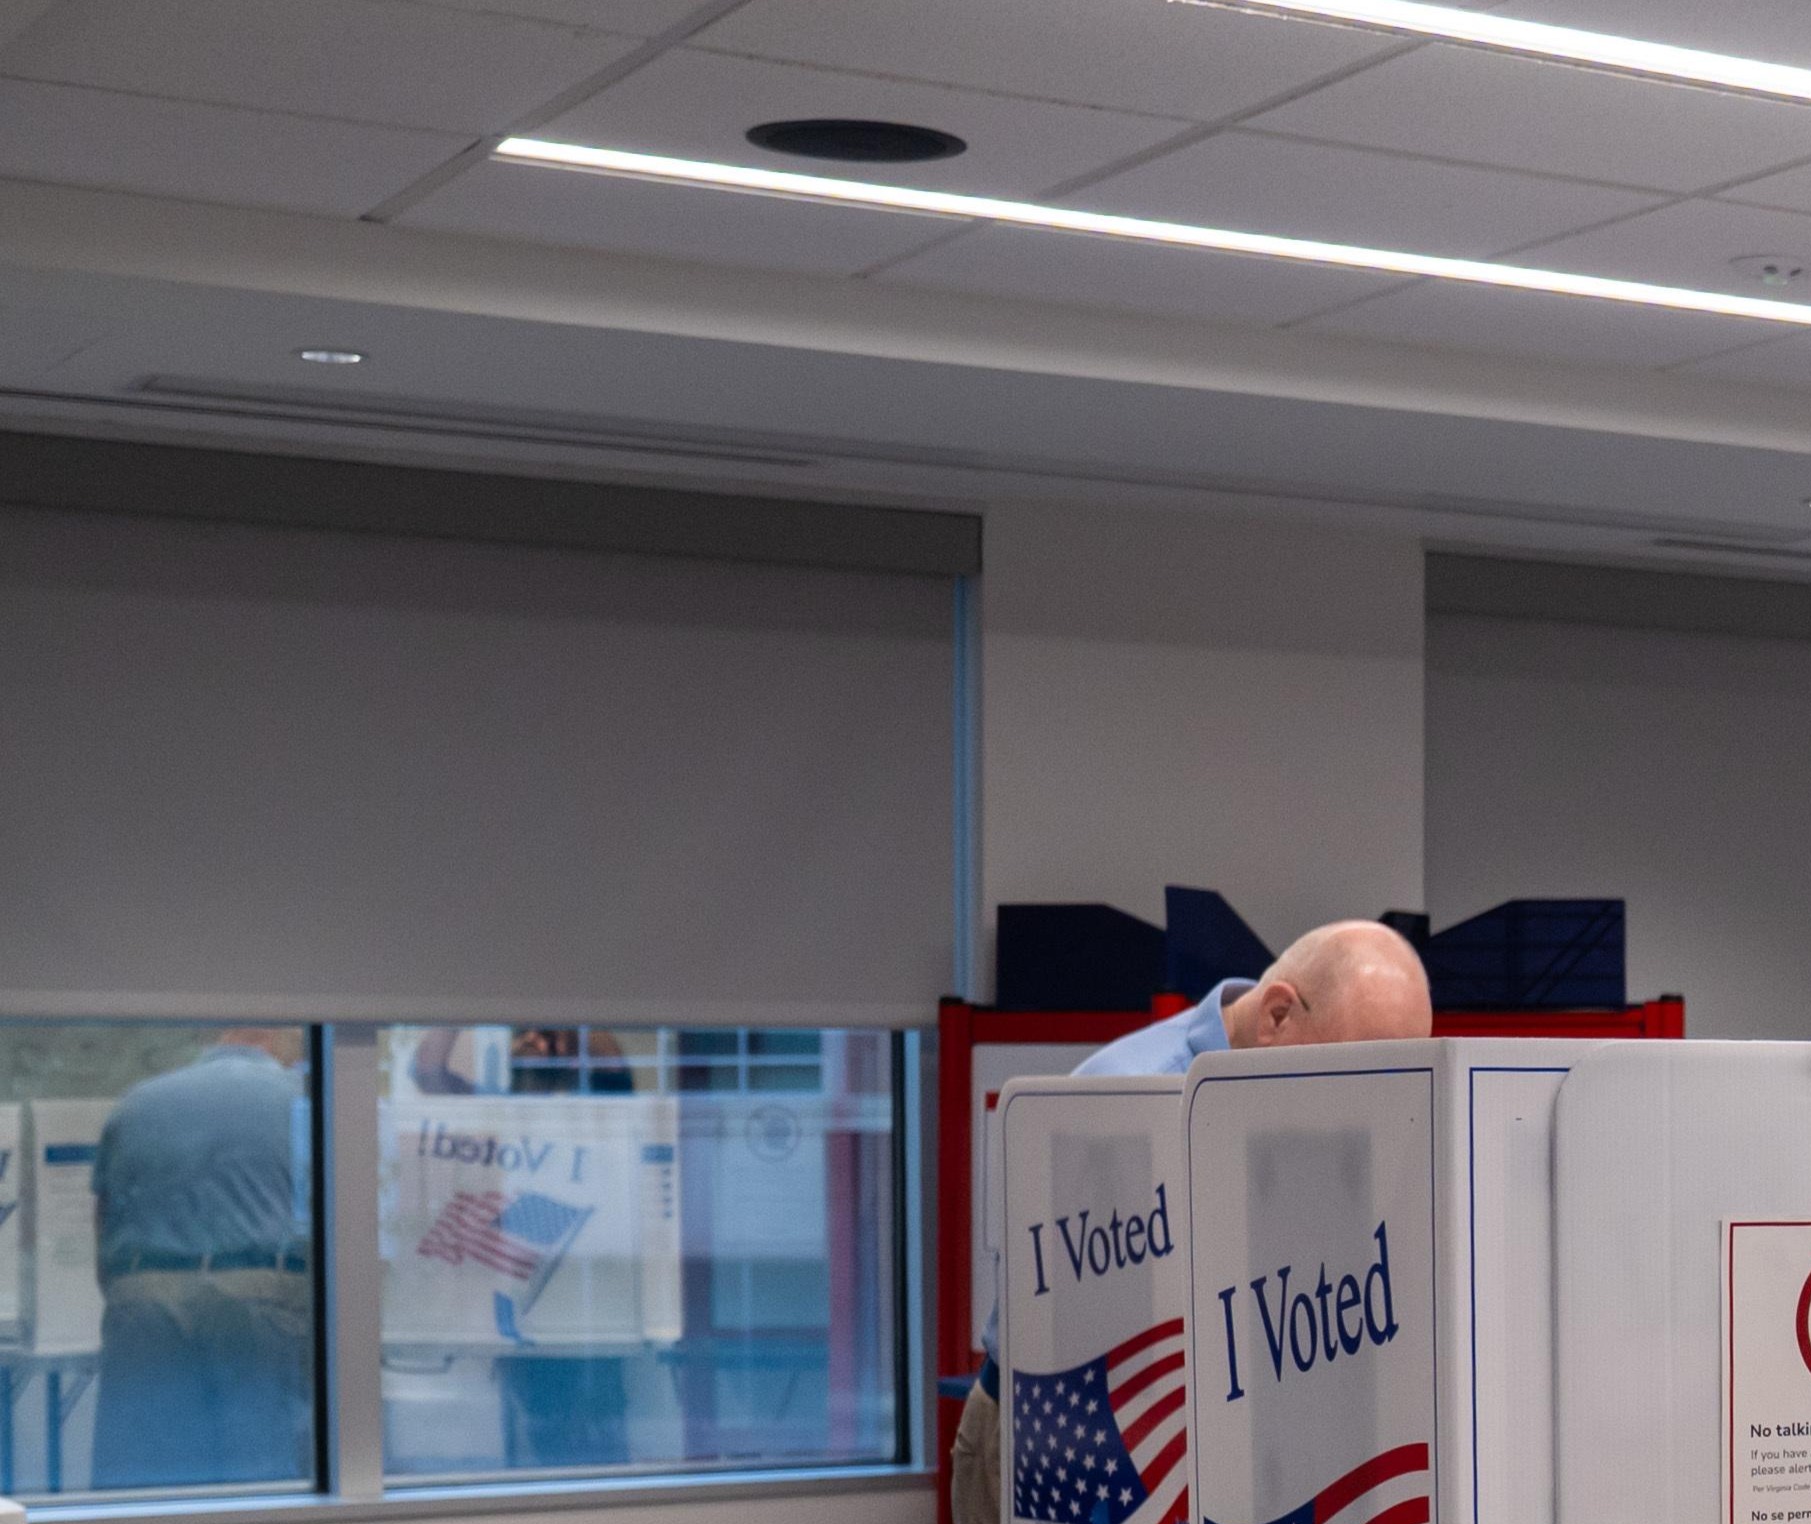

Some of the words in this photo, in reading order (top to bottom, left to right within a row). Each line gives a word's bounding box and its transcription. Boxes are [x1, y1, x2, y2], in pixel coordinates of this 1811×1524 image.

[1028, 1223, 1050, 1296] I
[1056, 1183, 1174, 1283] Voted
[1218, 1286, 1245, 1403] I
[1250, 1220, 1399, 1383] Voted
[1750, 1424, 1771, 1438] No
[1751, 1450, 1759, 1460] If
[1760, 1451, 1780, 1462] you
[1783, 1447, 1808, 1459] have
[1751, 1463, 1786, 1477] please
[1788, 1460, 1811, 1473] alert
[1751, 1510, 1768, 1521] No
[1771, 1511, 1784, 1521] se
